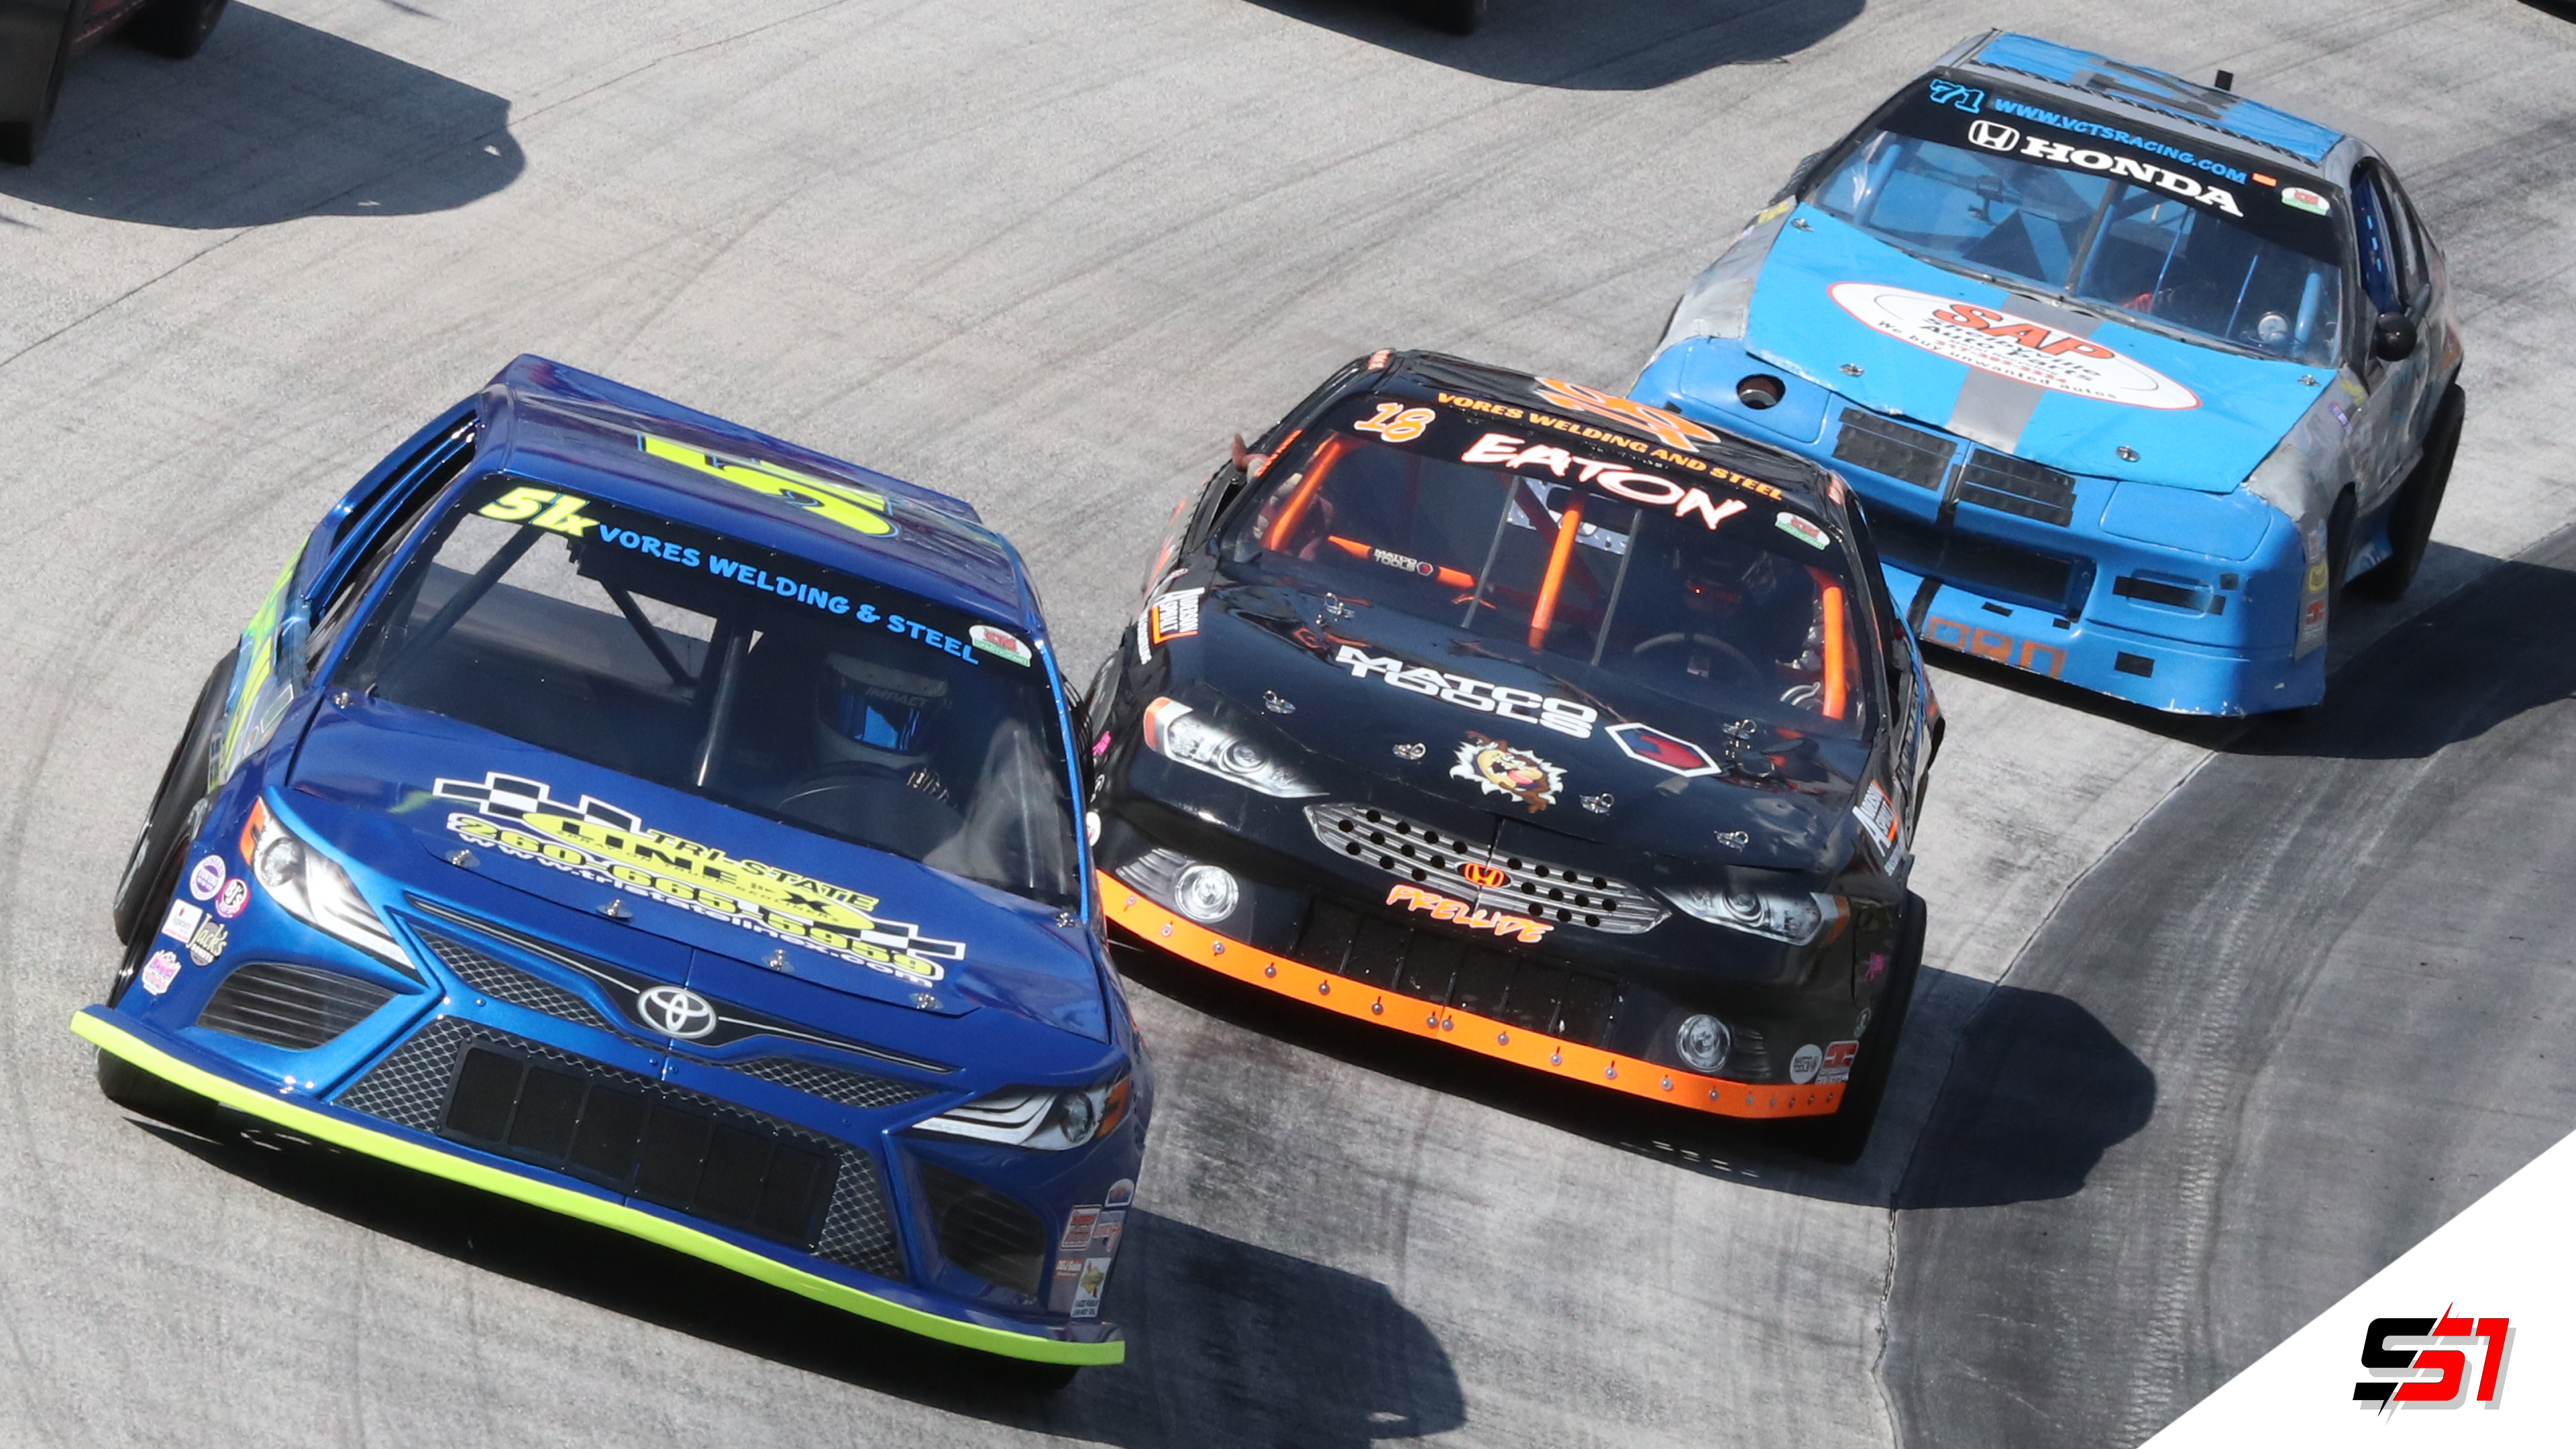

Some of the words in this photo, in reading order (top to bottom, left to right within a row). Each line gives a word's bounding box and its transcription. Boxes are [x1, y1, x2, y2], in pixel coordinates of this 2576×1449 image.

[1929, 78, 1985, 114] 71
[1994, 98, 2247, 185] WWW.VCTSRACING.COM
[2021, 136, 2245, 217] HONDA
[1878, 319, 1902, 334] We
[1909, 335, 1943, 352] buy
[1949, 351, 2051, 385] unwanted
[2060, 382, 2118, 400] autos
[1919, 325, 1994, 350] Auto
[1923, 317, 2101, 378] Shelbyville
[1933, 304, 2115, 359] SAP
[1354, 402, 1436, 443] 18
[1437, 392, 1522, 421] VORES
[1529, 413, 1648, 455] WELDING
[1650, 446, 1707, 475] AND
[1707, 468, 1783, 501] STEEL
[1461, 432, 1748, 531] EATON
[599, 523, 701, 568] VORES
[708, 554, 851, 615] WELDING
[855, 603, 881, 625] &
[887, 613, 980, 665] STEEL
[1374, 548, 1417, 564] MATCO
[1375, 556, 1415, 573] TOOLS
[1336, 645, 1599, 724] MATCO
[1347, 657, 1594, 739] TOOLS
[453, 814, 939, 978] 260-665-5959
[458, 833, 934, 988] www.tristatelinex.com
[647, 829, 880, 911] TRI-STATE
[185, 912, 229, 957] Jack's
[1386, 884, 1554, 943] PRELUDE
